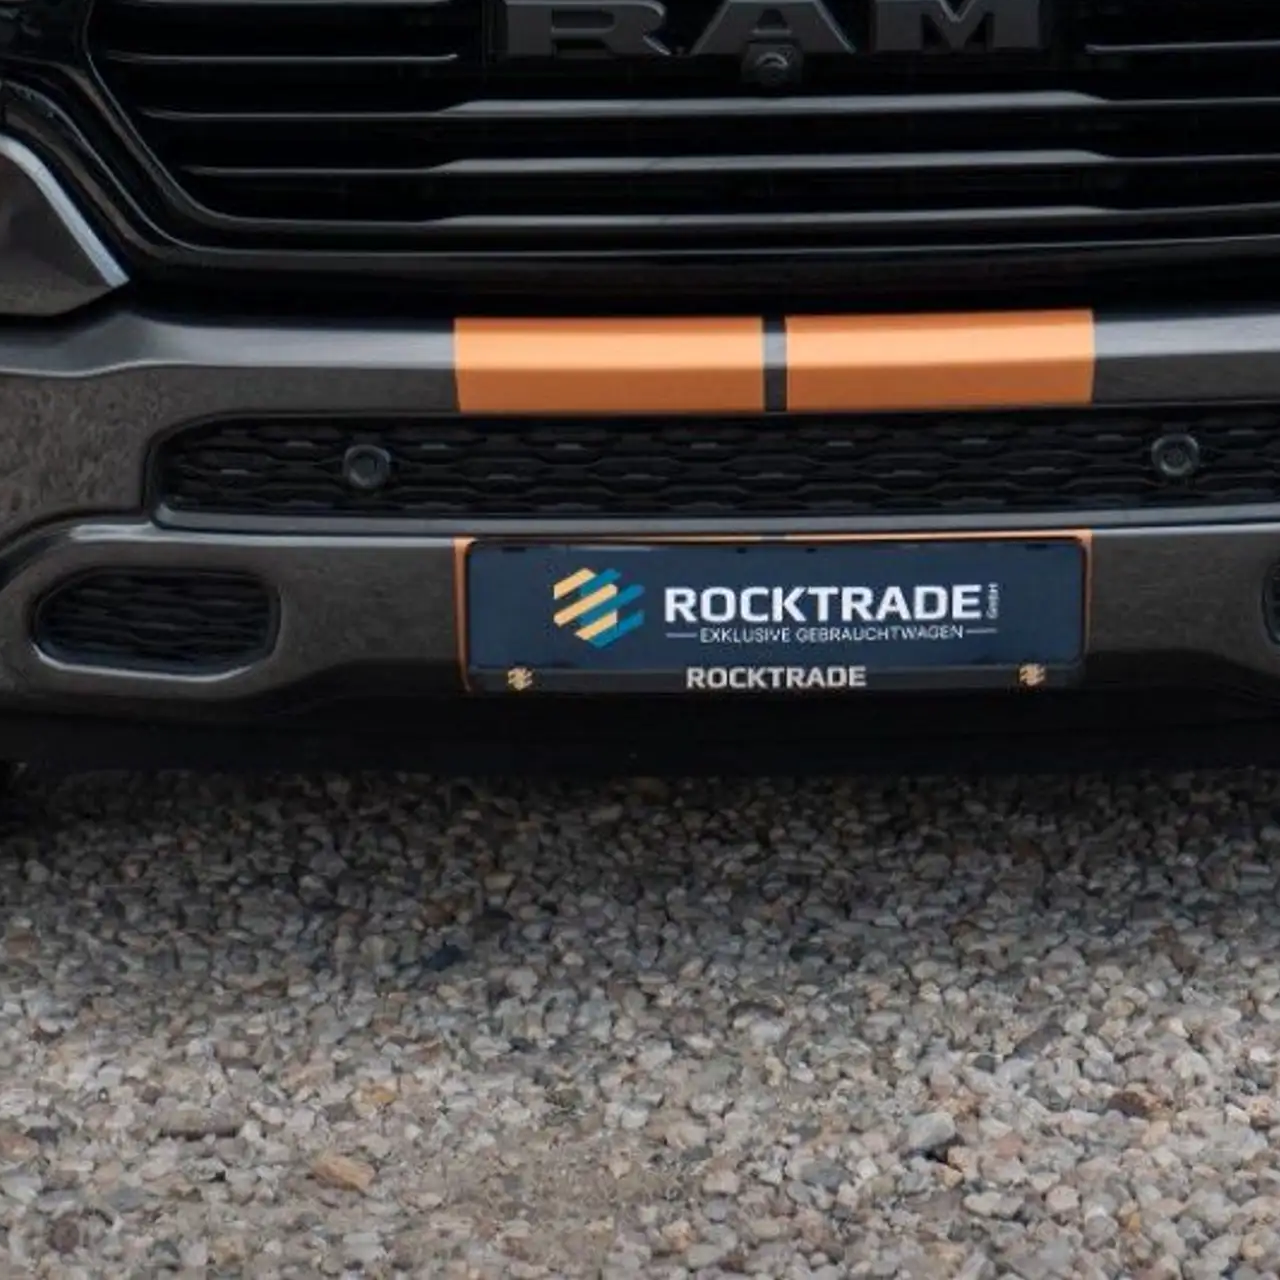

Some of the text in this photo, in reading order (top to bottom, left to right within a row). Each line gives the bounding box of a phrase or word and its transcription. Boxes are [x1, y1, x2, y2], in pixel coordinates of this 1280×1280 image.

[664, 584, 983, 622] ROCKTRADE
[699, 623, 964, 644] EXKLUSIVE GEBRAUCHTWAGEN
[685, 665, 868, 690] ROCKTRADE
